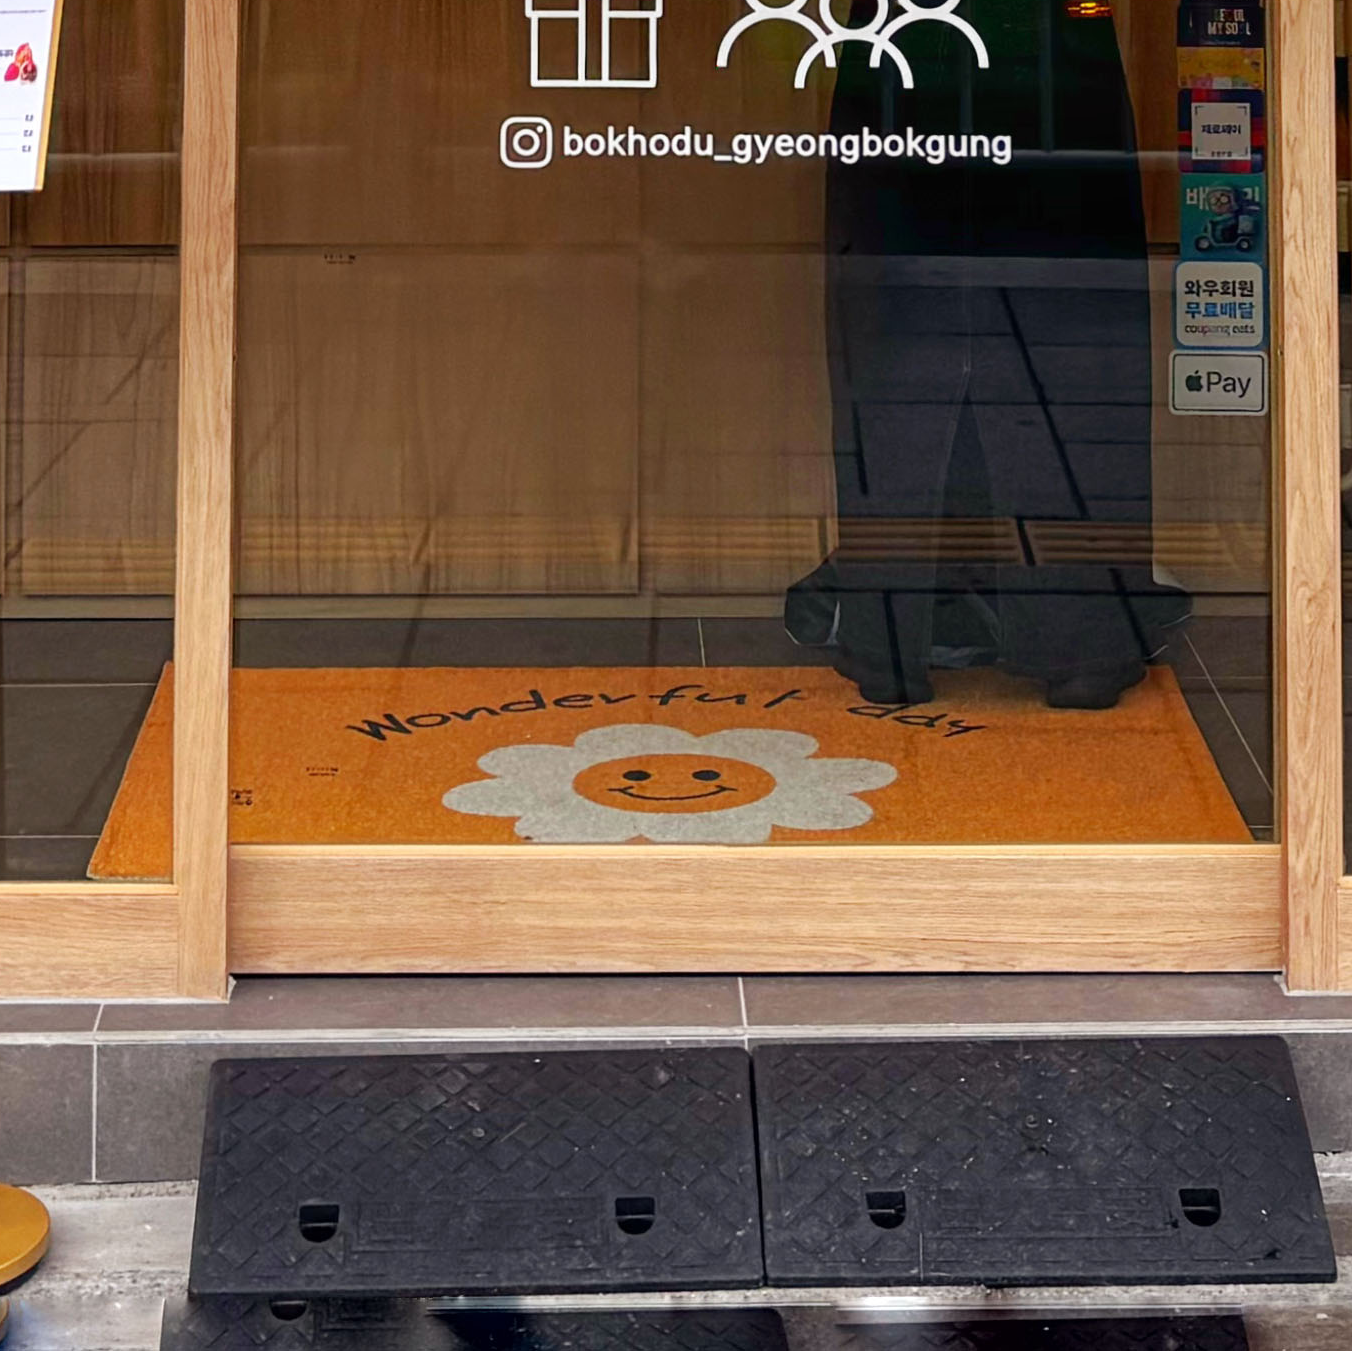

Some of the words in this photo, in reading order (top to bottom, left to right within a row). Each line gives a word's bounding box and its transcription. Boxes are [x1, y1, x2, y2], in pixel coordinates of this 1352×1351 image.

[1226, 22, 1251, 36] SOL
[563, 126, 1012, 164] bokhodu_gyeongbokgung
[1184, 279, 1254, 298] 와우회원
[1184, 302, 1255, 320] 무료배달
[1206, 371, 1252, 398] Pay
[346, 684, 801, 742] Wonderful
